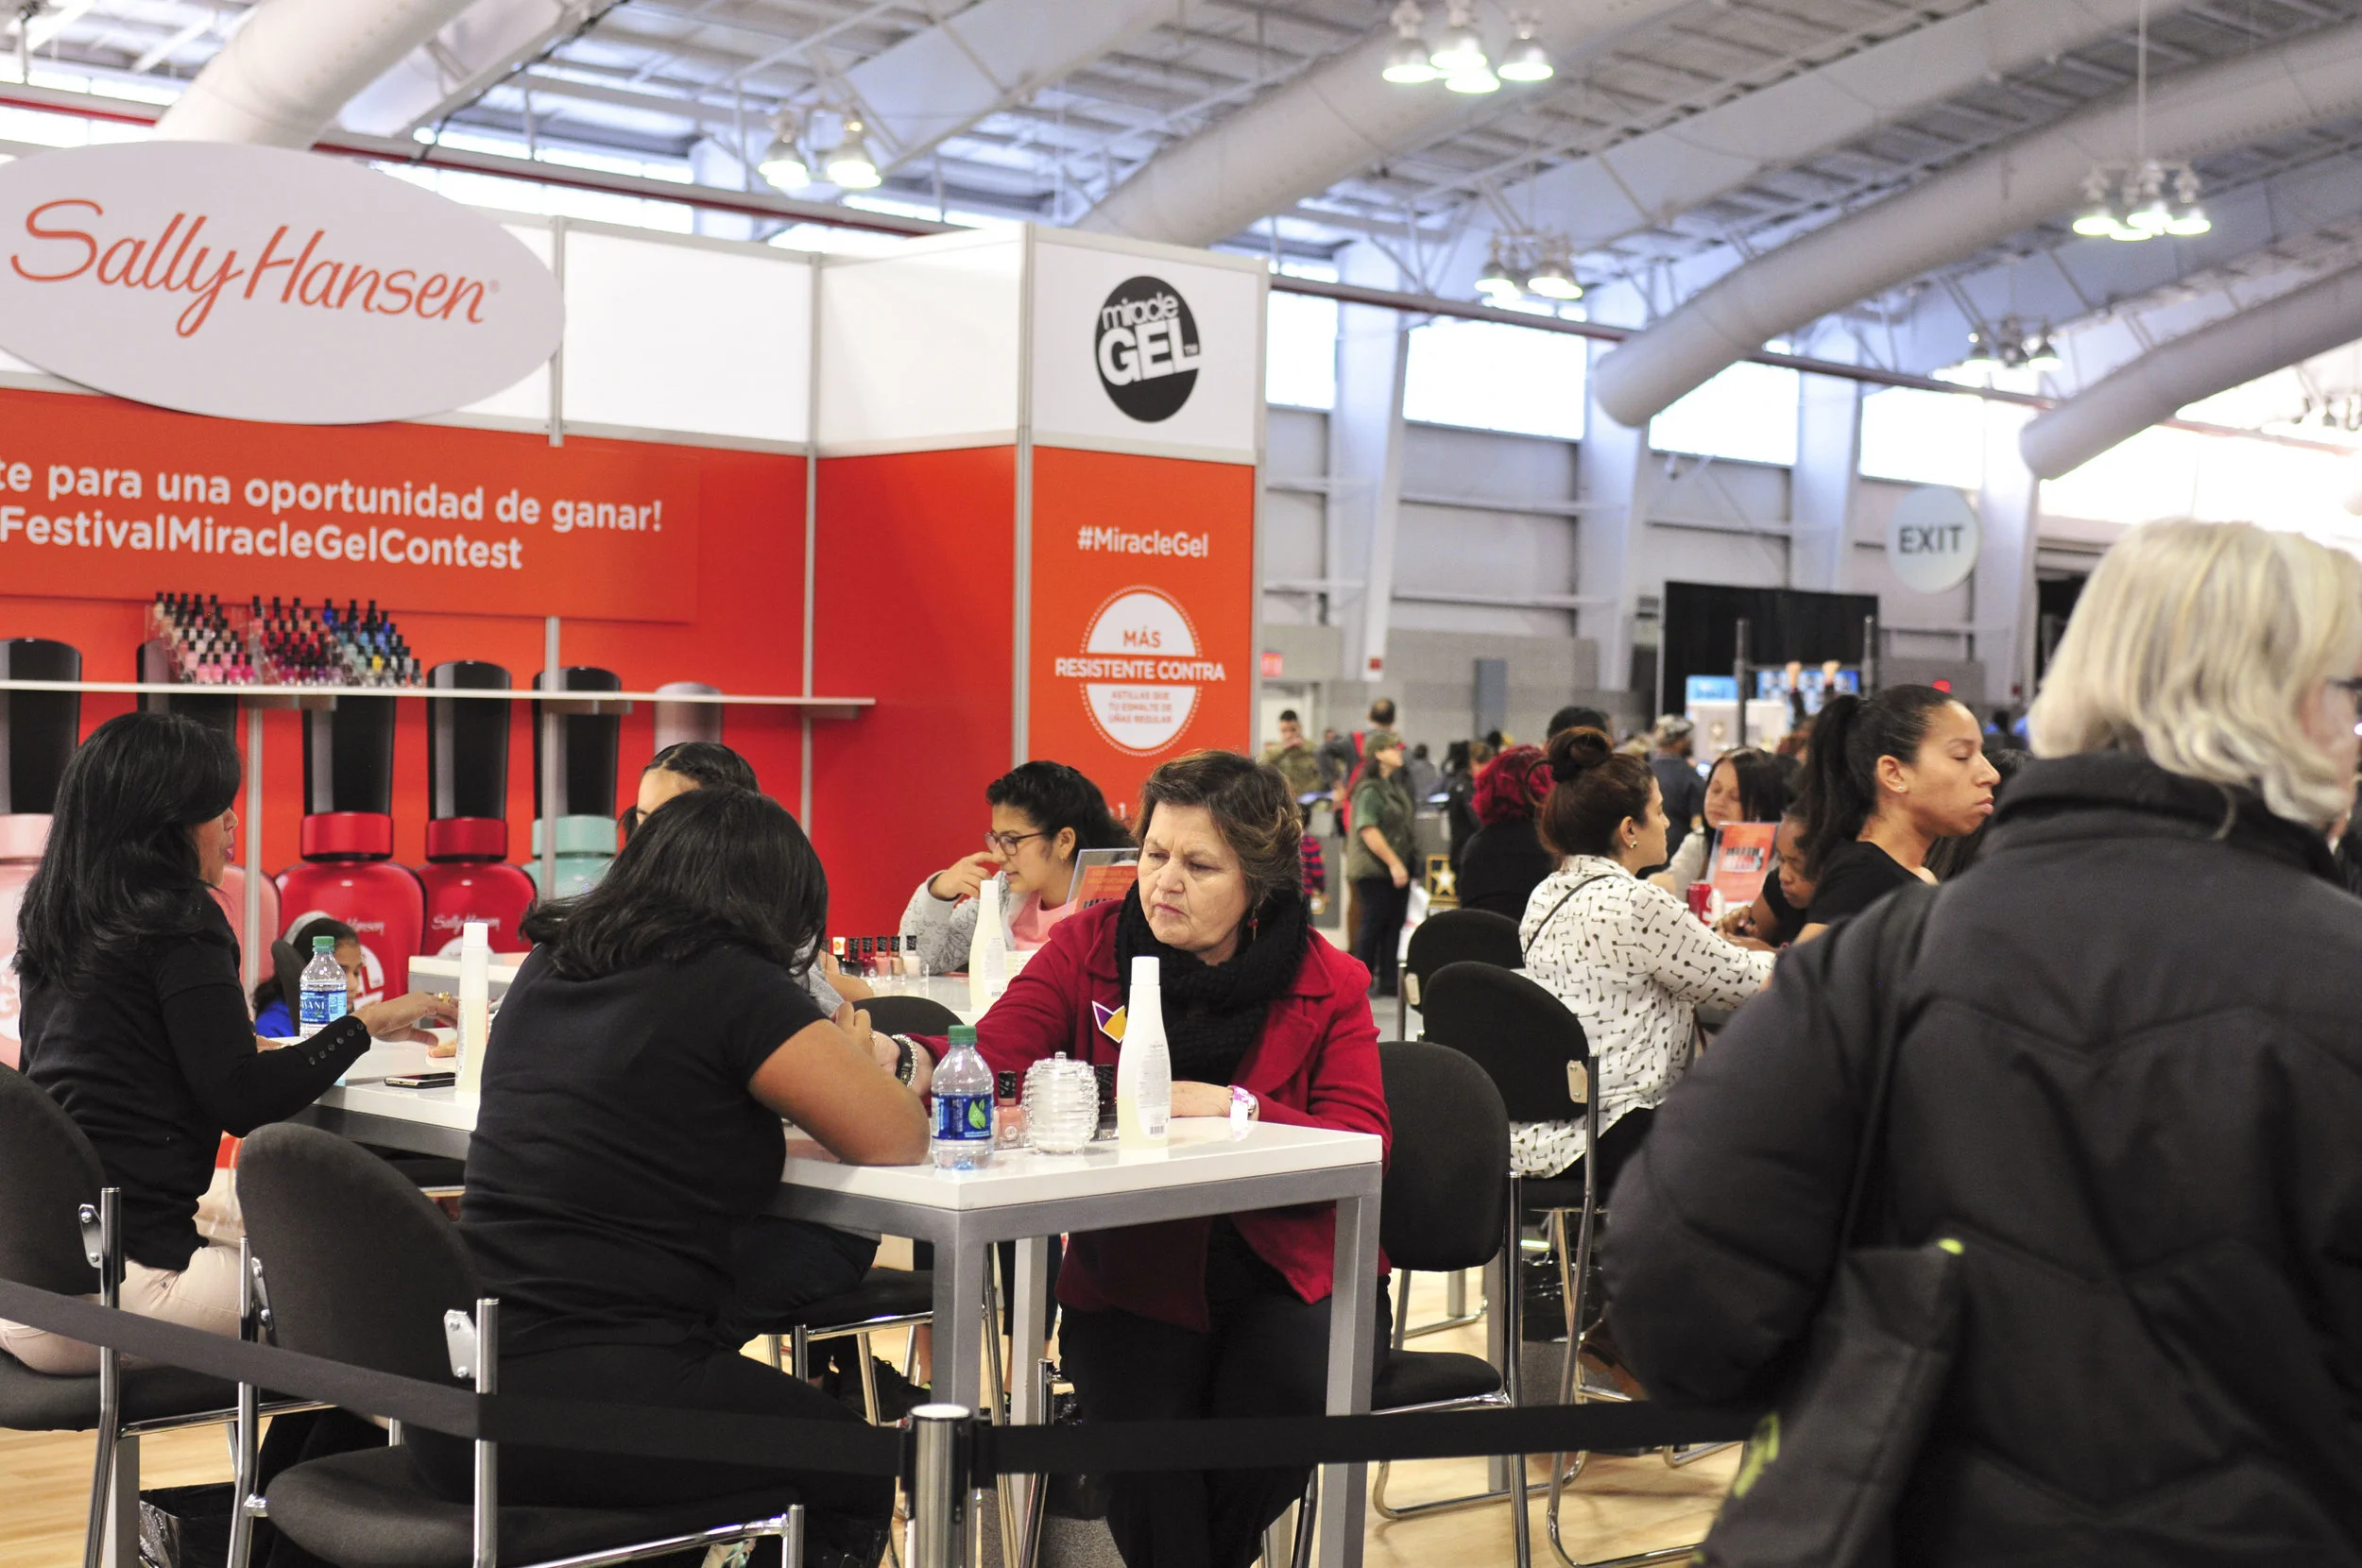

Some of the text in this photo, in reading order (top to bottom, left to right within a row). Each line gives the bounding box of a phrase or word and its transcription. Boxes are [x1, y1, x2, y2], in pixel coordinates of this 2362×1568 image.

[10, 198, 485, 338] Sally Hansen
[1099, 317, 1202, 386] GEL
[48, 464, 143, 502] para
[157, 472, 231, 504] una
[245, 478, 485, 520] oportunidad
[496, 488, 541, 524] de
[552, 500, 661, 532] ganar!
[0, 506, 523, 570] FestivalMiracleGelContest
[1077, 525, 1208, 558] #MiracleGel
[1898, 523, 1964, 555] EXIT
[1122, 624, 1161, 649] MÁS
[1054, 657, 1226, 681] RESISTENTE CONTRA
